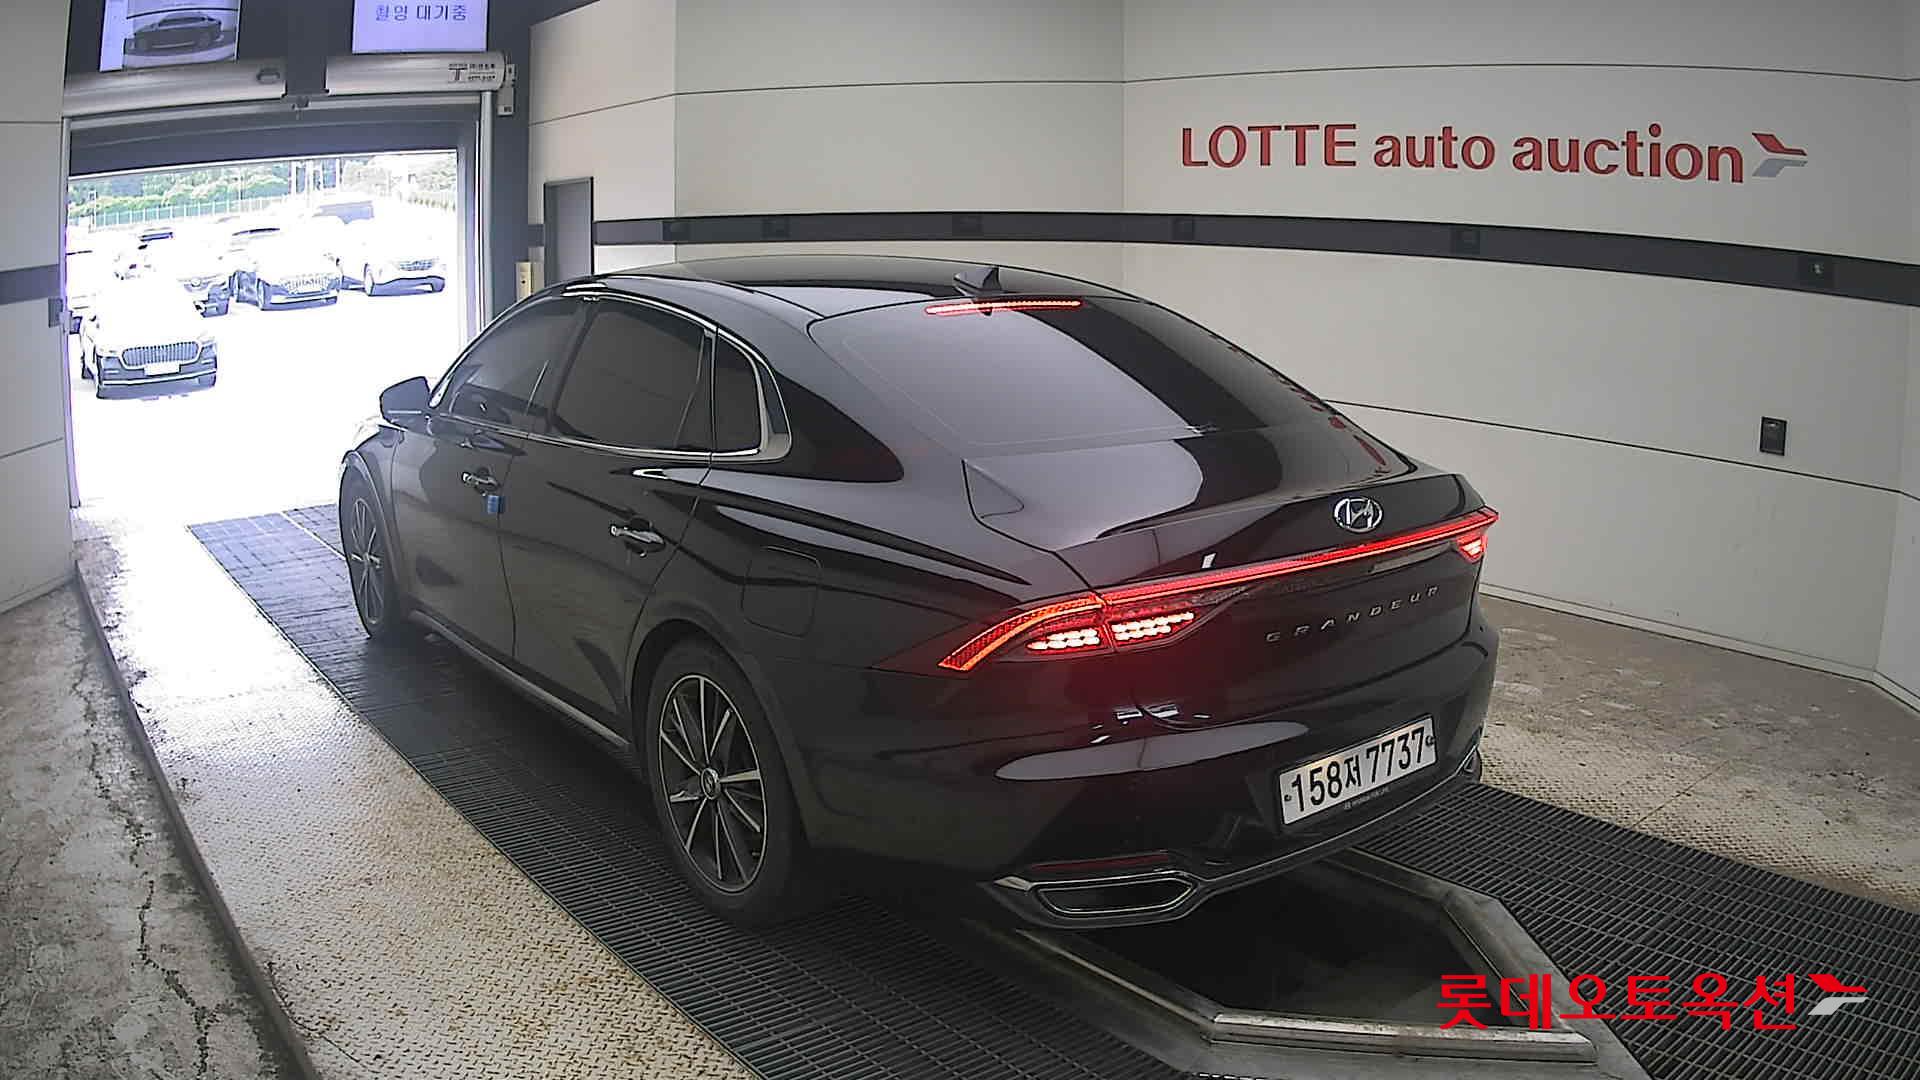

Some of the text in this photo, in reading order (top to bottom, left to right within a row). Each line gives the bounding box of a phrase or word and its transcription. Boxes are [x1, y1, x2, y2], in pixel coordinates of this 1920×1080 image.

[416, 4, 467, 21] 대기중
[1182, 123, 1744, 184] LOTTE auto auction
[1265, 585, 1438, 642] GRANDEUR
[1291, 755, 1361, 812] 158저
[1366, 726, 1425, 783] 7737
